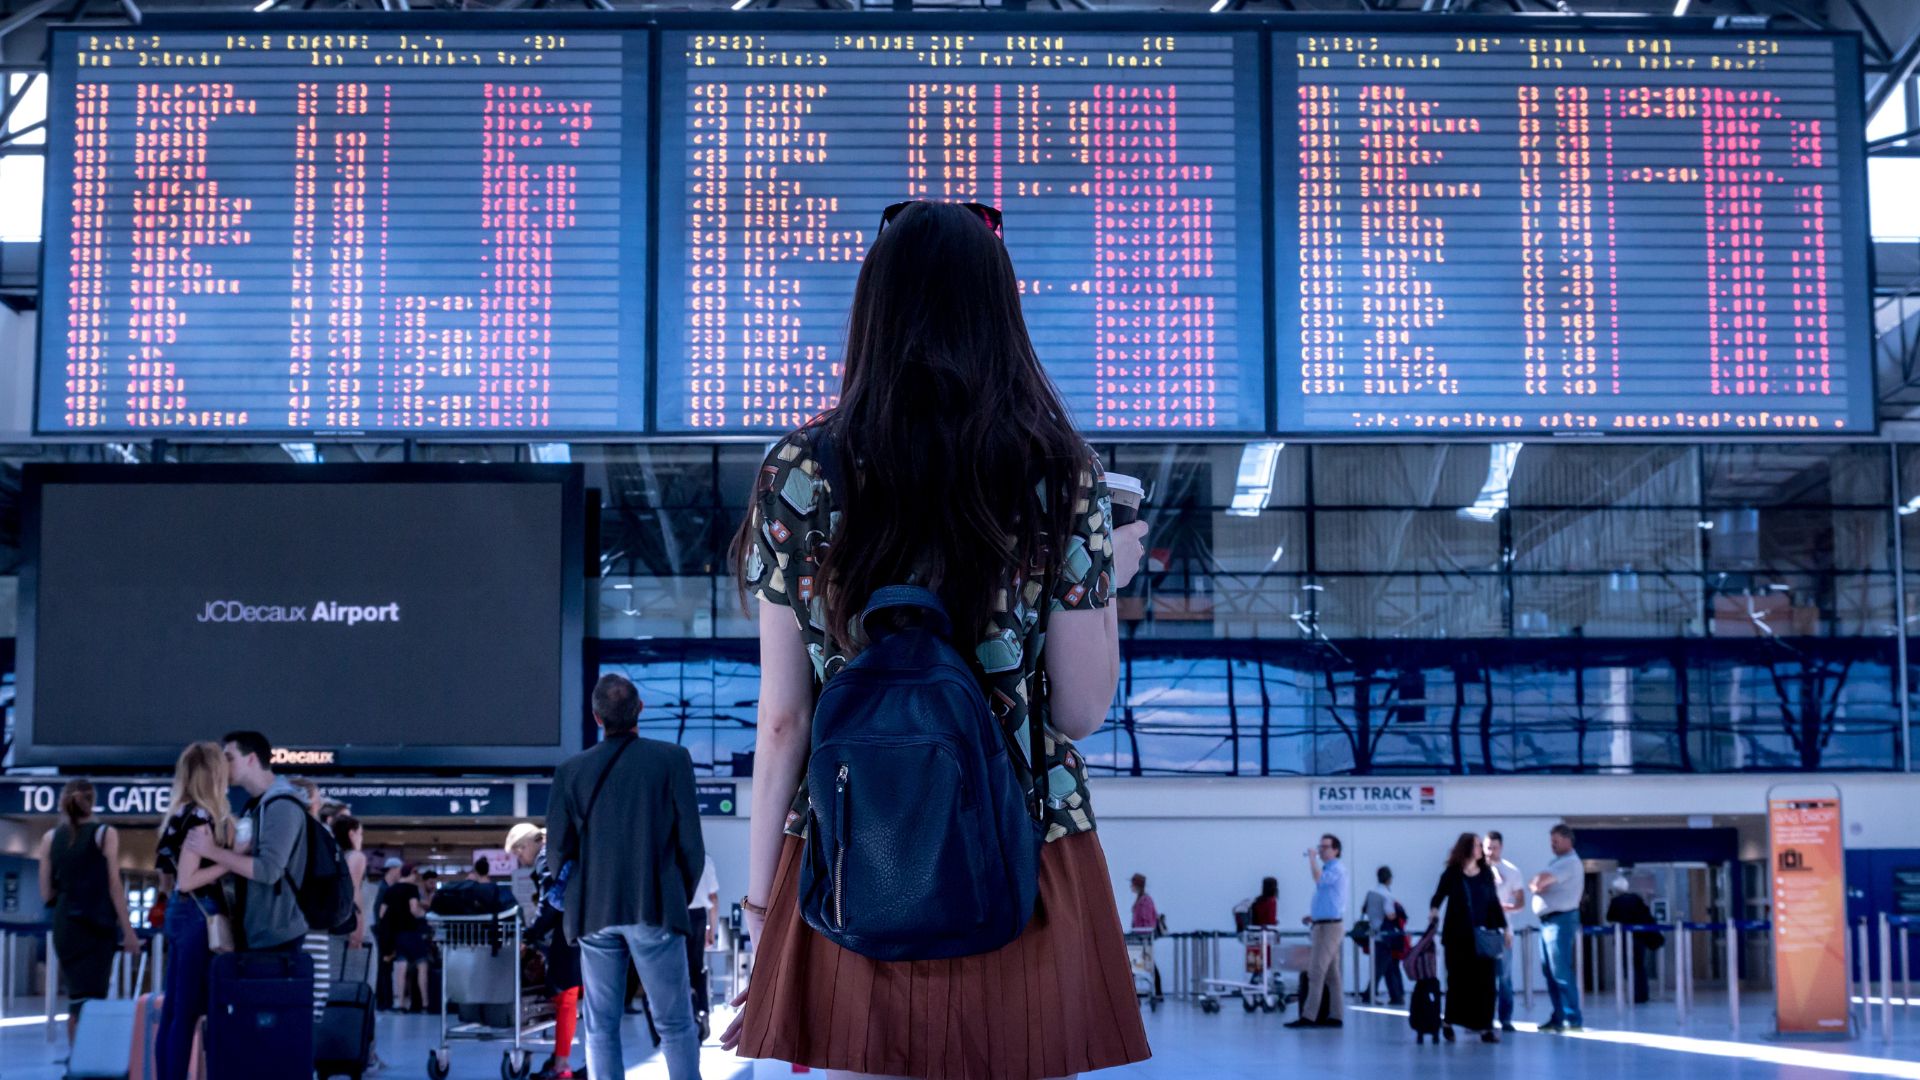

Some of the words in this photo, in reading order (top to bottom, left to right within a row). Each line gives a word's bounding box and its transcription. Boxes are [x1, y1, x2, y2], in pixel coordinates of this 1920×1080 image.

[197, 600, 306, 622] JCDecaux
[311, 601, 399, 626] Airport
[18, 785, 55, 812] TO
[108, 785, 171, 812] GATE
[328, 787, 348, 797] YOUR
[349, 787, 387, 797] PASSPORT
[388, 787, 405, 797] AND
[405, 787, 444, 797] BOARDING
[445, 787, 464, 797] PASS
[464, 787, 490, 797] READY
[1318, 786, 1357, 801] FAST
[1360, 786, 1413, 801] TRACK
